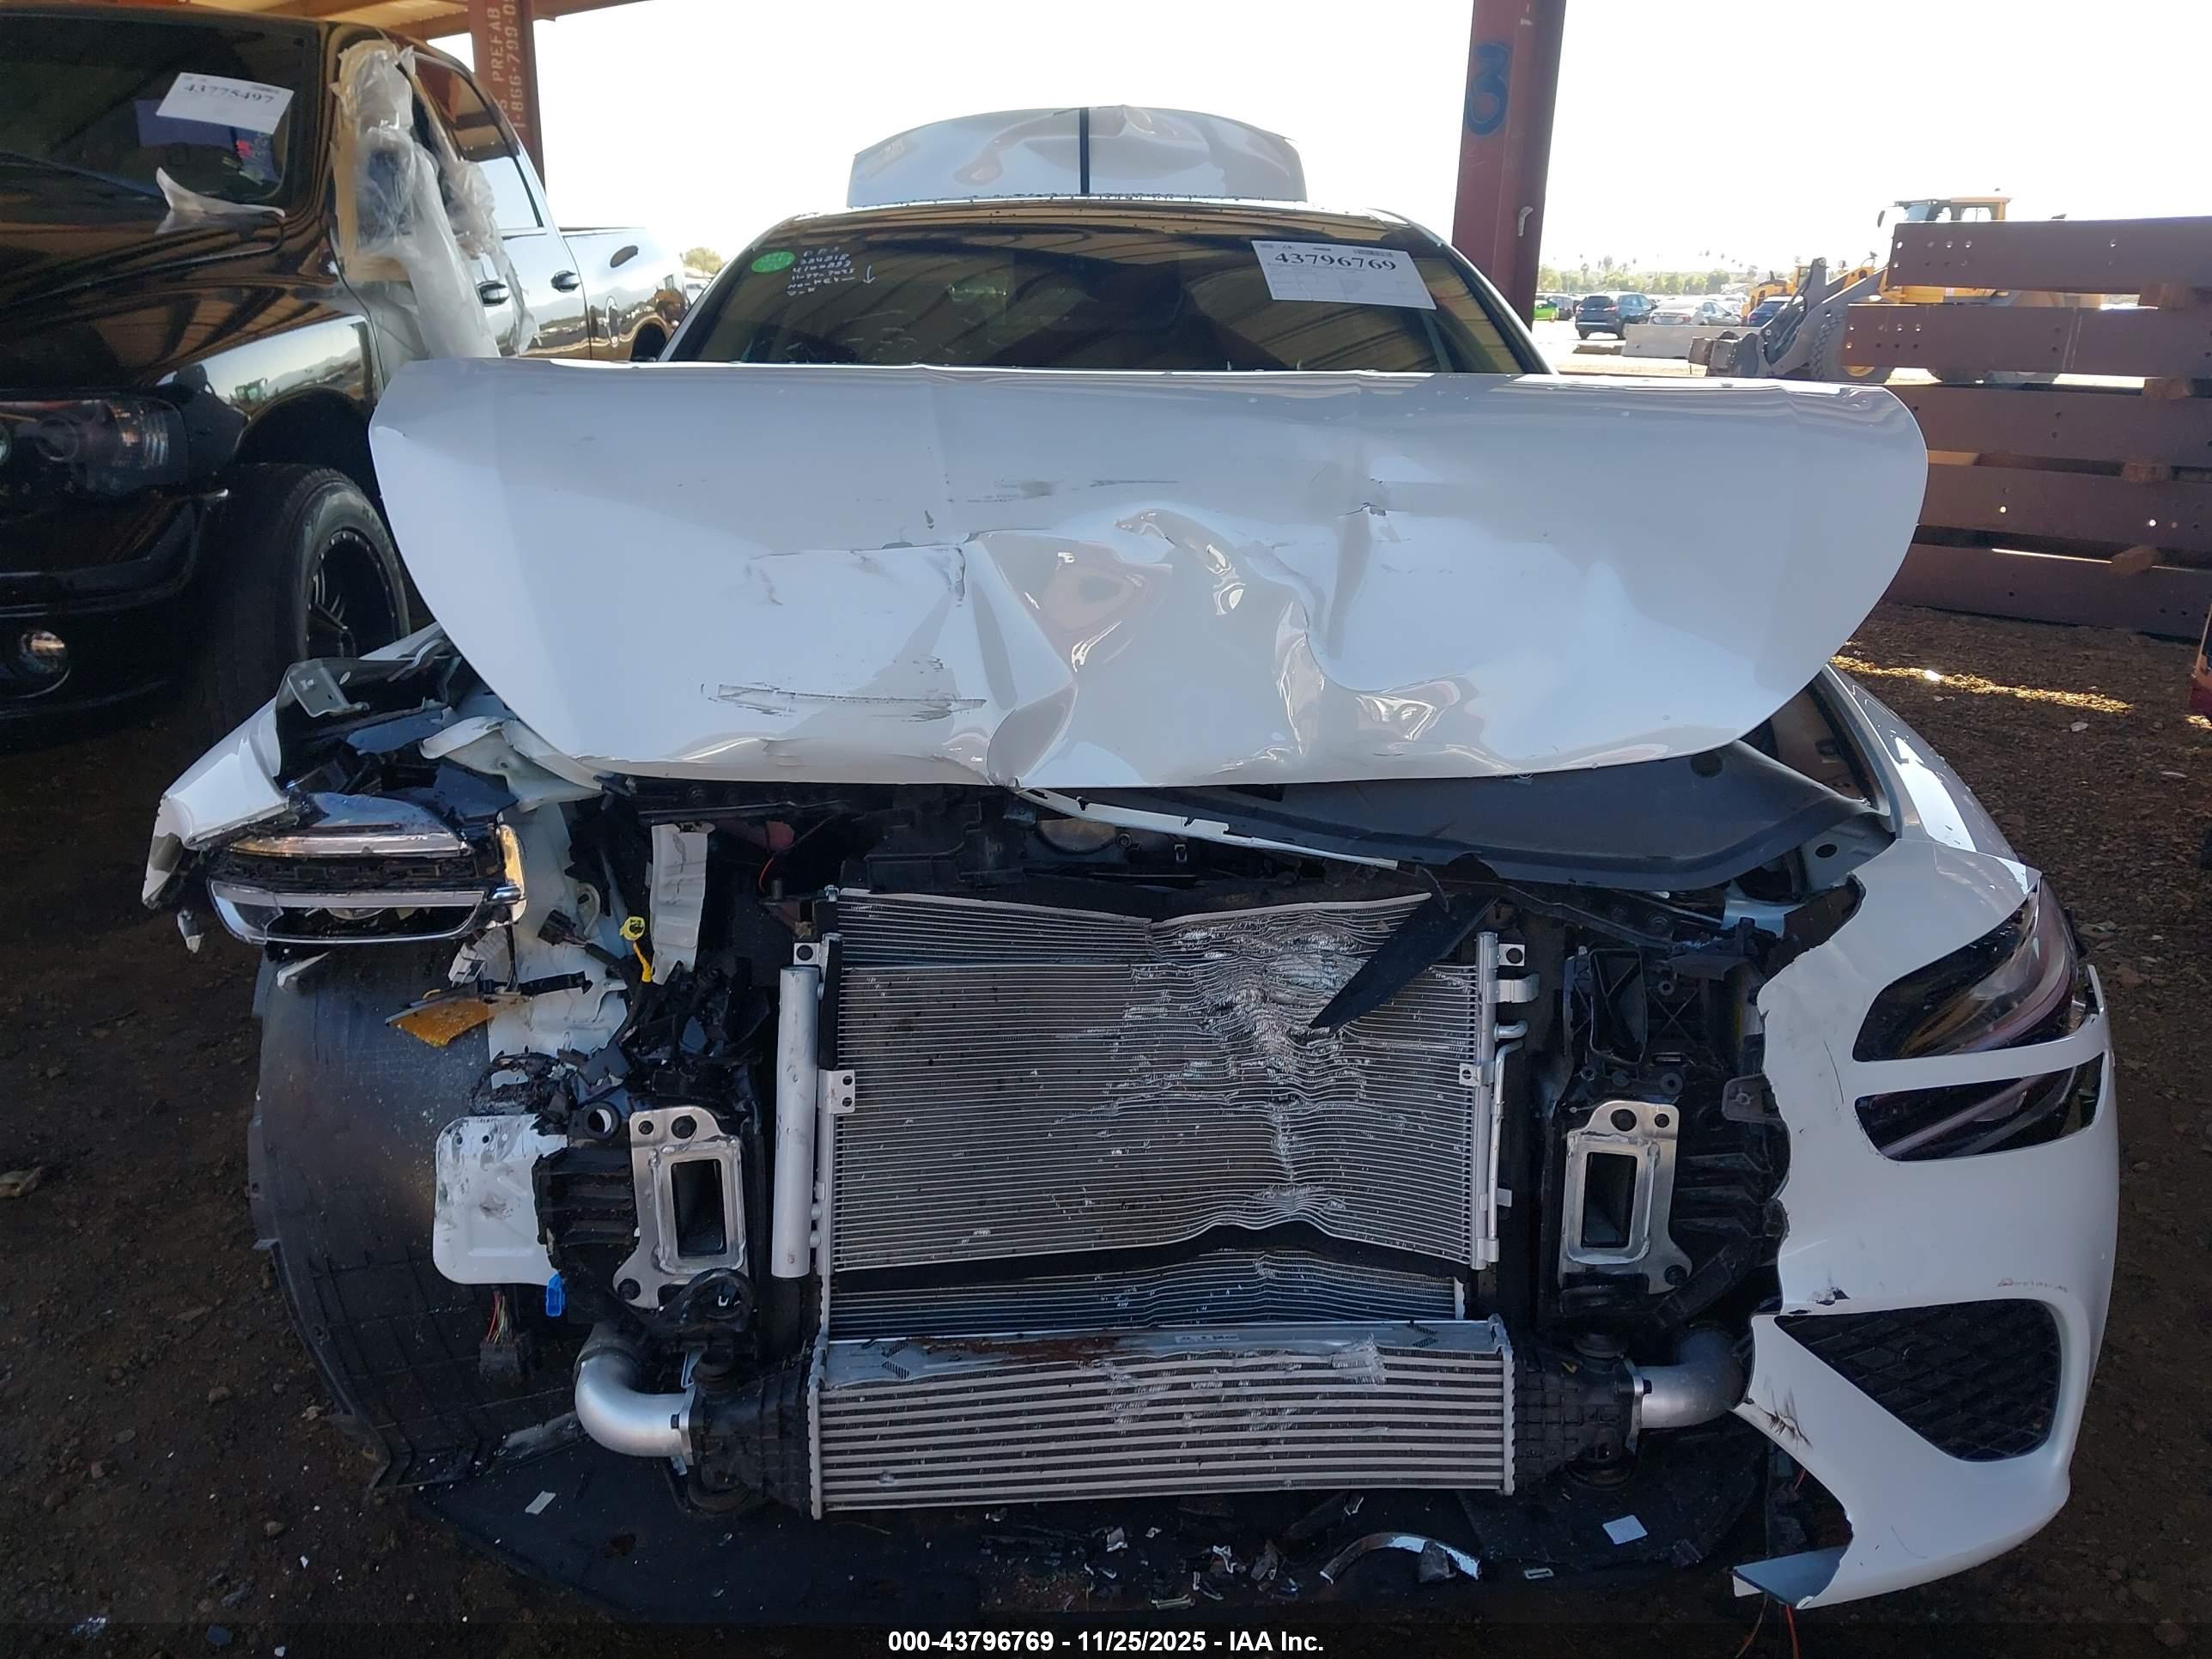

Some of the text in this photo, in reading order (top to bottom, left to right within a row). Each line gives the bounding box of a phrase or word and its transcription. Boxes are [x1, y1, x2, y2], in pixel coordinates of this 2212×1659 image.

[487, 7, 504, 82] PREFAB
[502, 0, 526, 128] 1-866-799-0
[1274, 252, 1397, 271] 43796769
